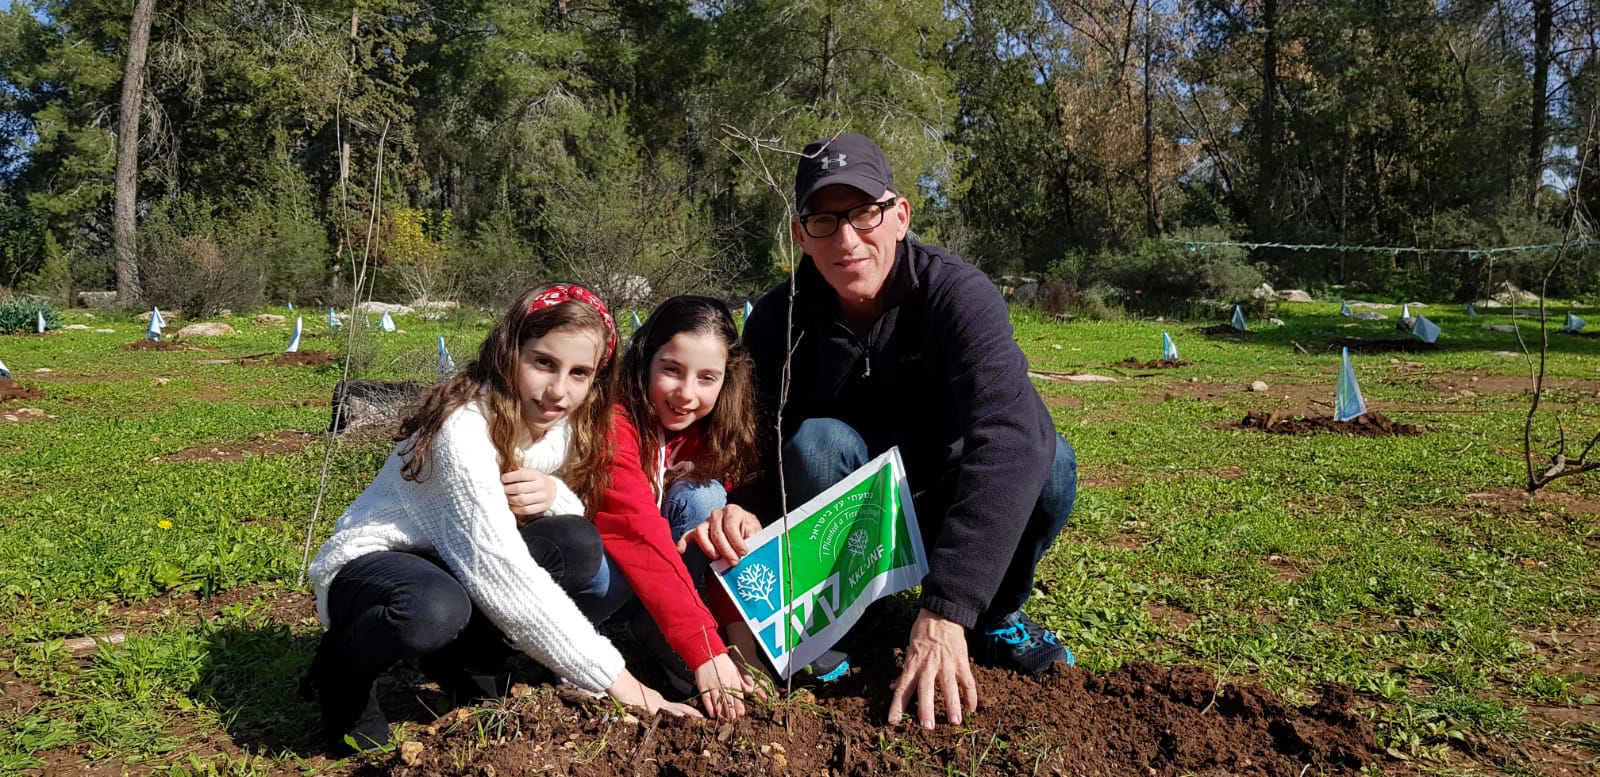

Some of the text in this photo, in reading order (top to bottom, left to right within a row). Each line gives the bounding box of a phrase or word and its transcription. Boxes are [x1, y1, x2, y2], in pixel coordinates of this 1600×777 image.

[809, 492, 873, 541] נטעתי עץ בישראל
[822, 523, 839, 552] Planted
[844, 509, 859, 520] Tree
[848, 544, 885, 588] KKL-JNF
